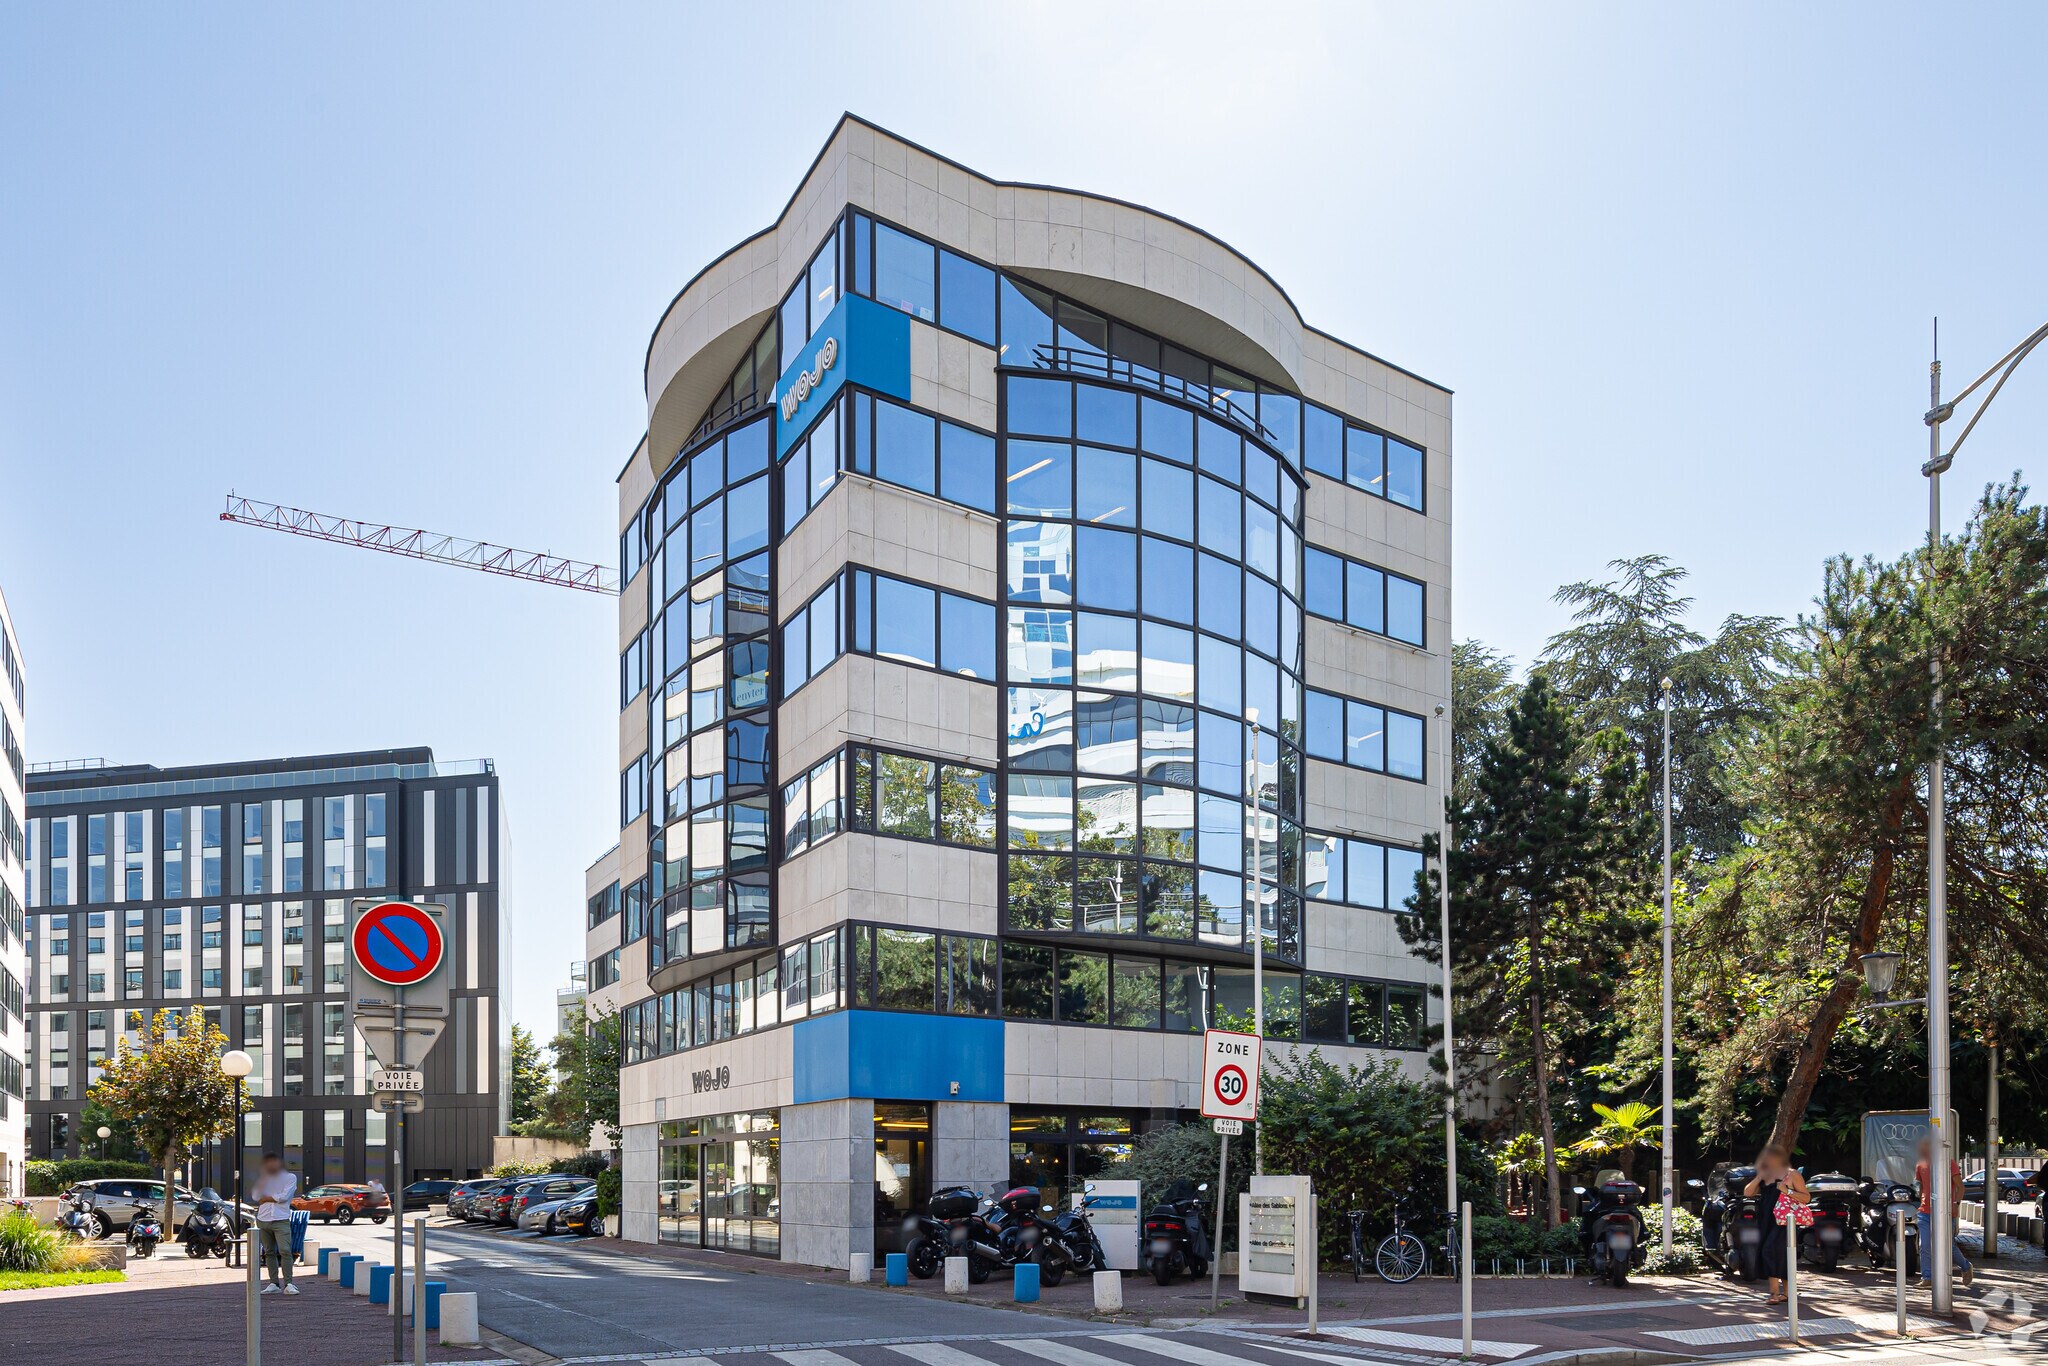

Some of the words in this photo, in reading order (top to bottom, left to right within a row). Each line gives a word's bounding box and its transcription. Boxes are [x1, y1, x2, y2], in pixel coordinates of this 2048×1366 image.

[781, 336, 838, 422] WOJO
[1217, 1042, 1249, 1056] ZONE
[385, 1072, 412, 1080] VOIE
[692, 1065, 730, 1093] WOJO
[378, 1080, 419, 1089] PRIVÉE
[1220, 1076, 1241, 1095] 30
[1221, 1119, 1237, 1127] VOIE
[1216, 1126, 1240, 1135] PRIVÉE
